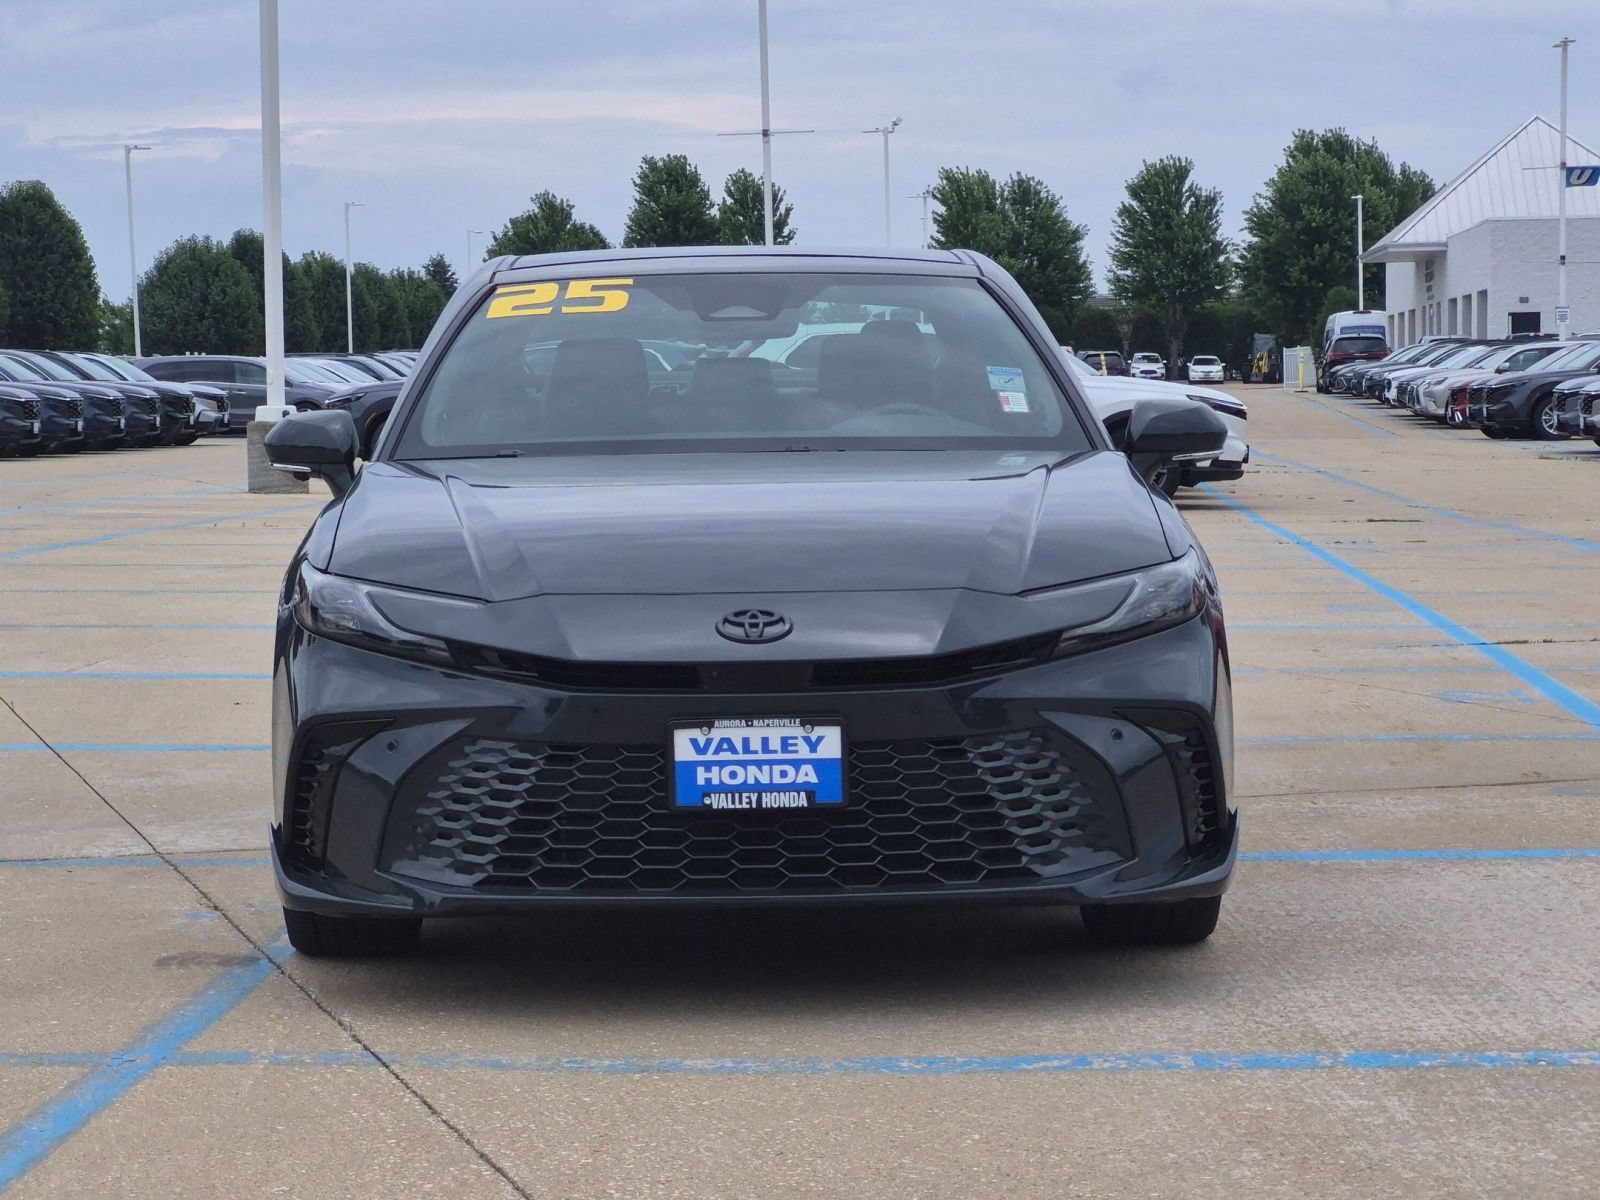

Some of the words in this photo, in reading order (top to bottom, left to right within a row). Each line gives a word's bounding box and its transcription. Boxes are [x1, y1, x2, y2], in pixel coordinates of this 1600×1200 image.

[486, 278, 634, 319] 25
[714, 719, 747, 728] AURORA
[753, 718, 801, 727] NAPERVILLE
[688, 735, 826, 756] VALLEY
[696, 764, 819, 785] HONDA
[710, 792, 759, 809] VALLEY
[762, 791, 808, 808] HONDA
